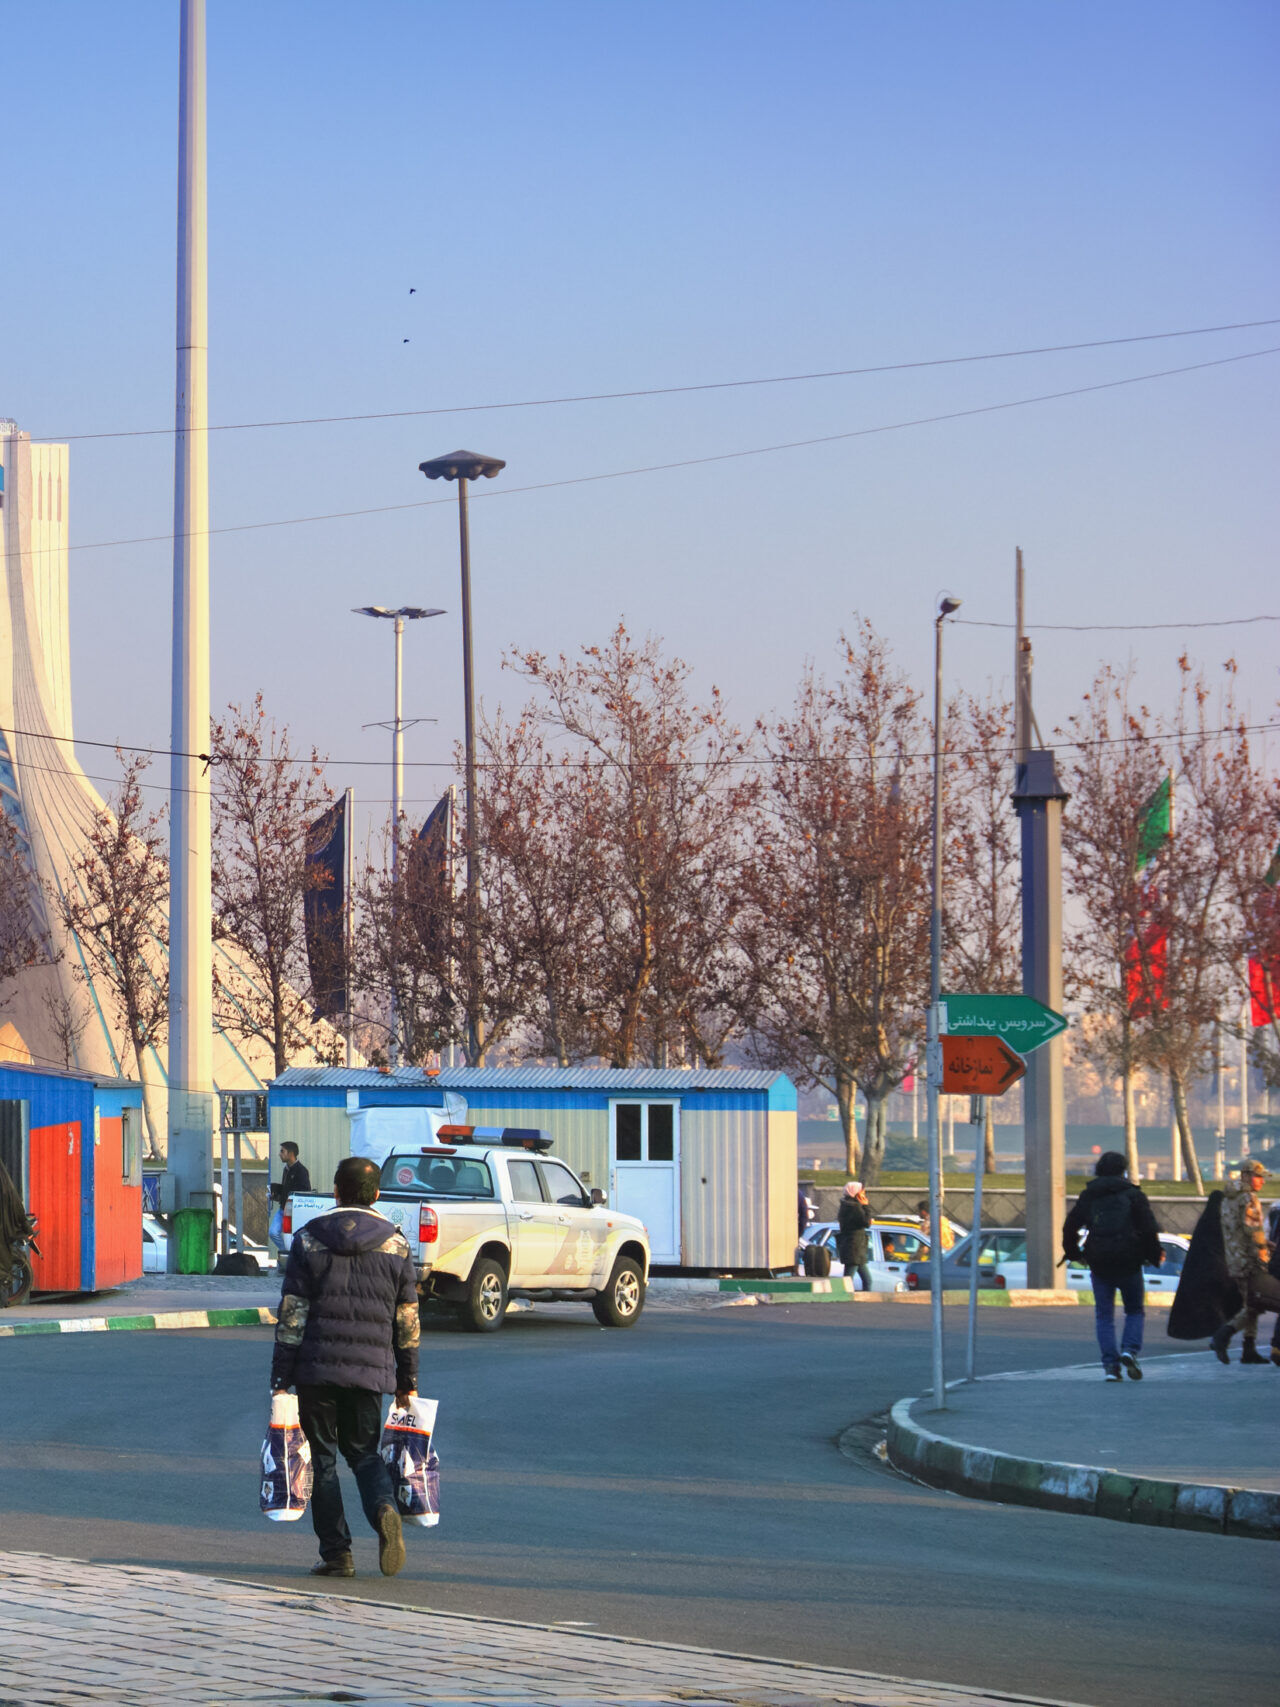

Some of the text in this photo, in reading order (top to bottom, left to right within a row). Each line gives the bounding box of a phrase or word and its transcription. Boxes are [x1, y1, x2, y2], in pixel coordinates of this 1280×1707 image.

[948, 1014, 1047, 1032] سرویس بهداشتی
[948, 1056, 993, 1082] نمازخانه
